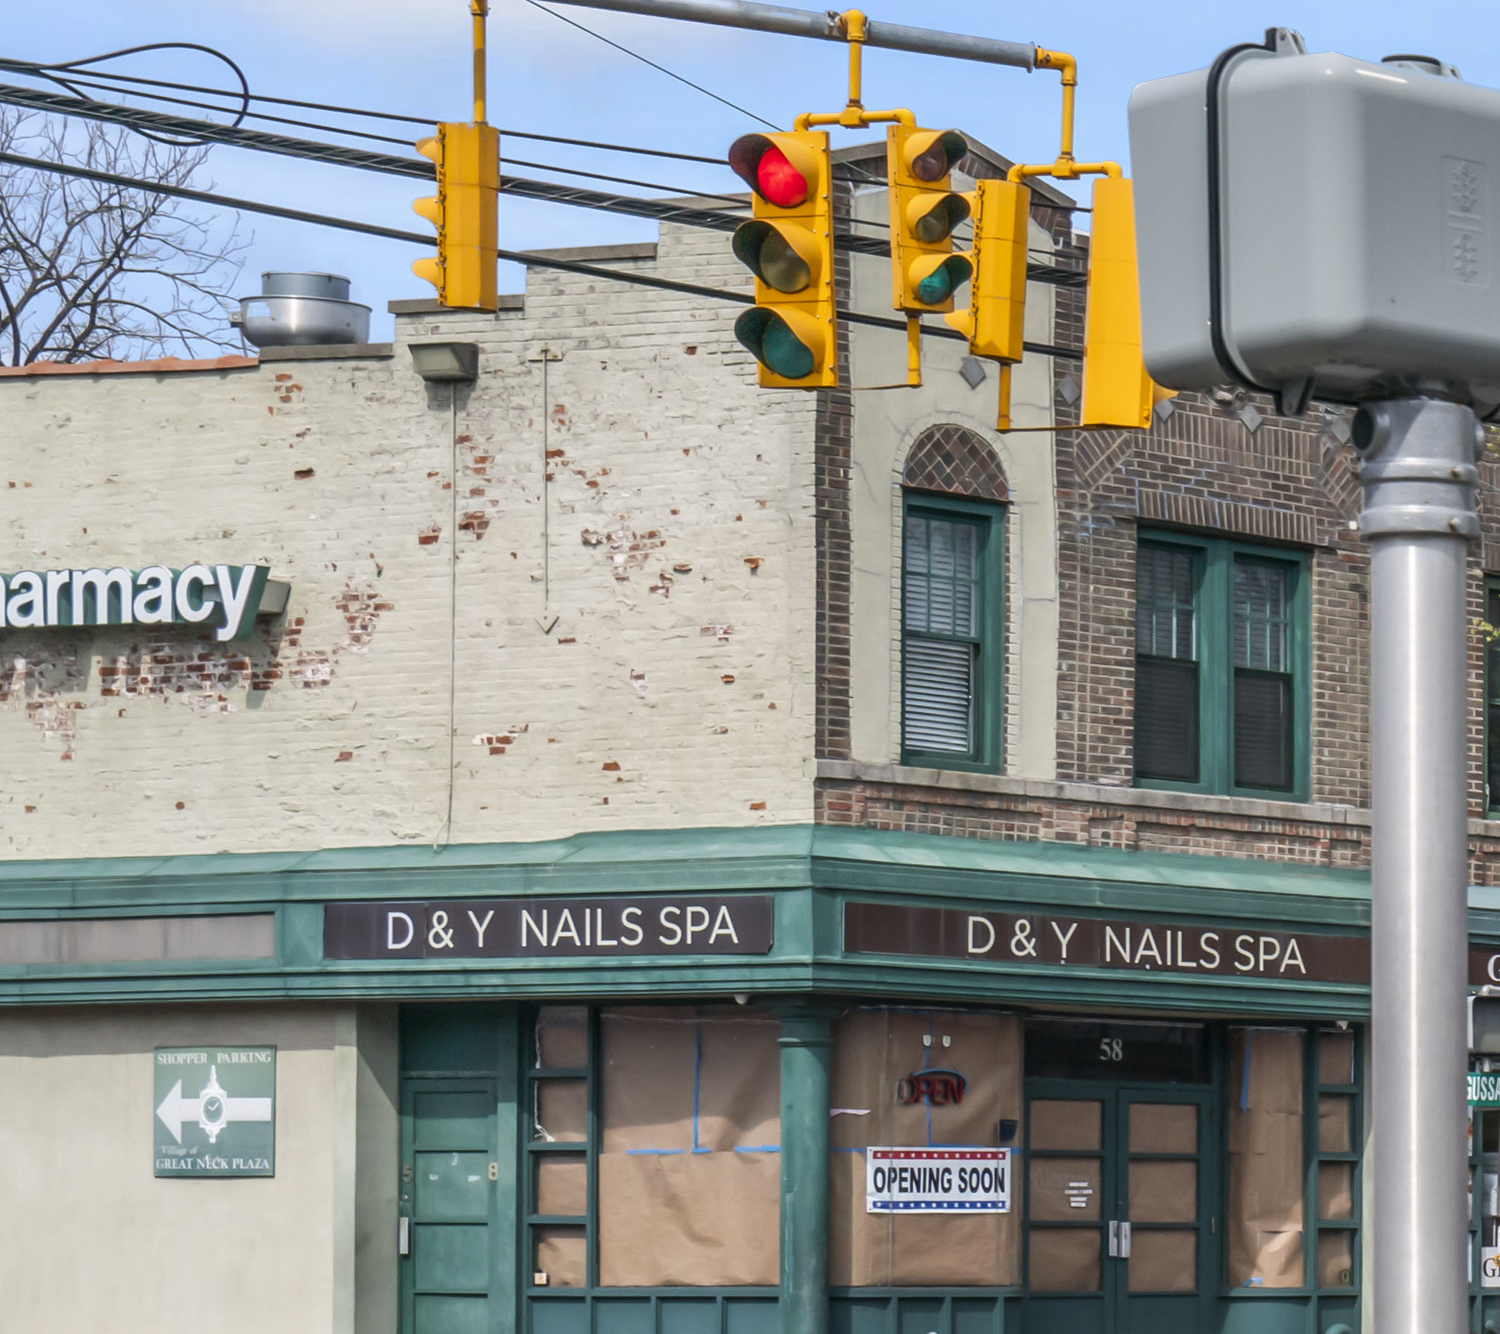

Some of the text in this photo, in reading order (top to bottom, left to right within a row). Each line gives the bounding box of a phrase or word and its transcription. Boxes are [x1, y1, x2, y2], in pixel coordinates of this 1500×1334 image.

[0, 563, 256, 642] armacy
[386, 905, 739, 949] D & Y NAILS SPA
[967, 916, 1307, 975] D & Y NAILS SPA
[157, 1051, 271, 1065] SHOPPER PARKING
[1100, 1038, 1123, 1061] 58
[900, 1077, 965, 1106] OPEN
[156, 1158, 270, 1169] GREAT NECK PLAZA
[161, 1146, 188, 1156] Village
[873, 1166, 1006, 1194] OPENING SOON
